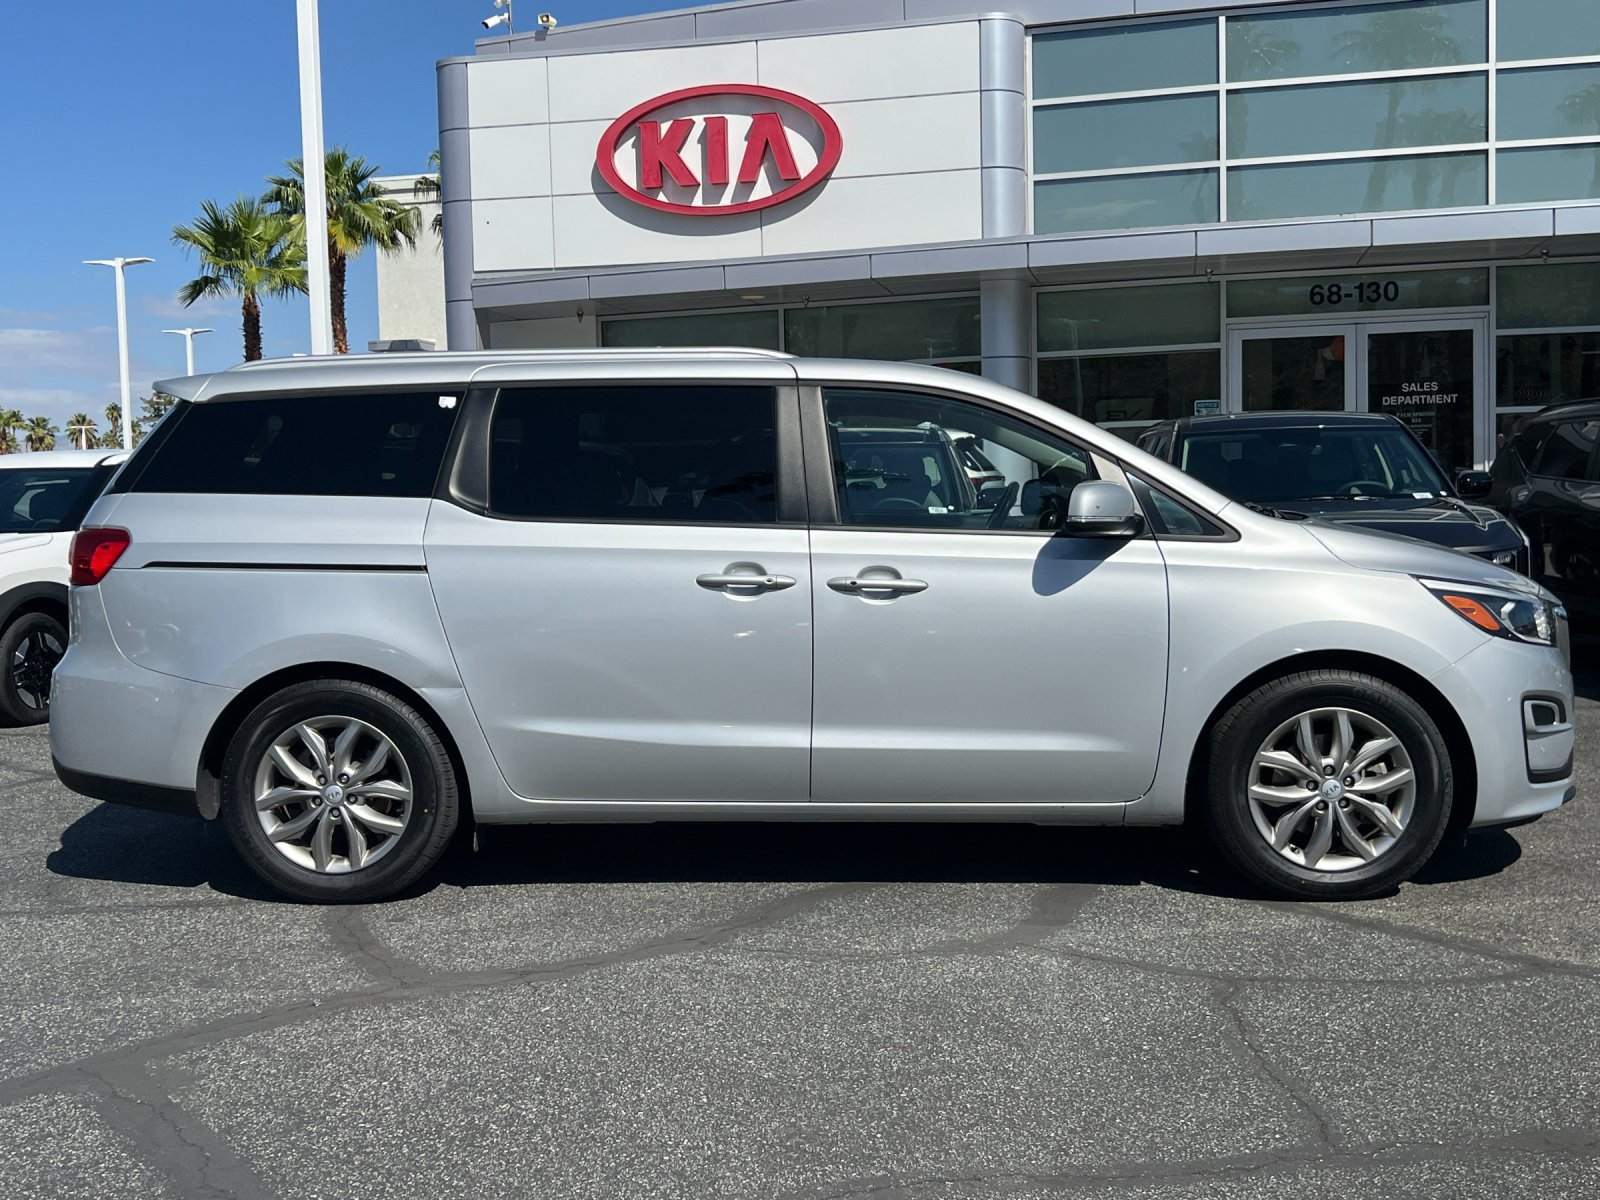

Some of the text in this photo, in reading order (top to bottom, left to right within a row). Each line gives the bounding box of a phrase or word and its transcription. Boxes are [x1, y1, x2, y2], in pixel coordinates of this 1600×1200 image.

[637, 112, 801, 189] KIA
[1309, 281, 1399, 305] 68-130
[1402, 381, 1438, 392] SALES
[1382, 394, 1459, 405] DEPARTMENT
[1323, 785, 1340, 797] KIA
